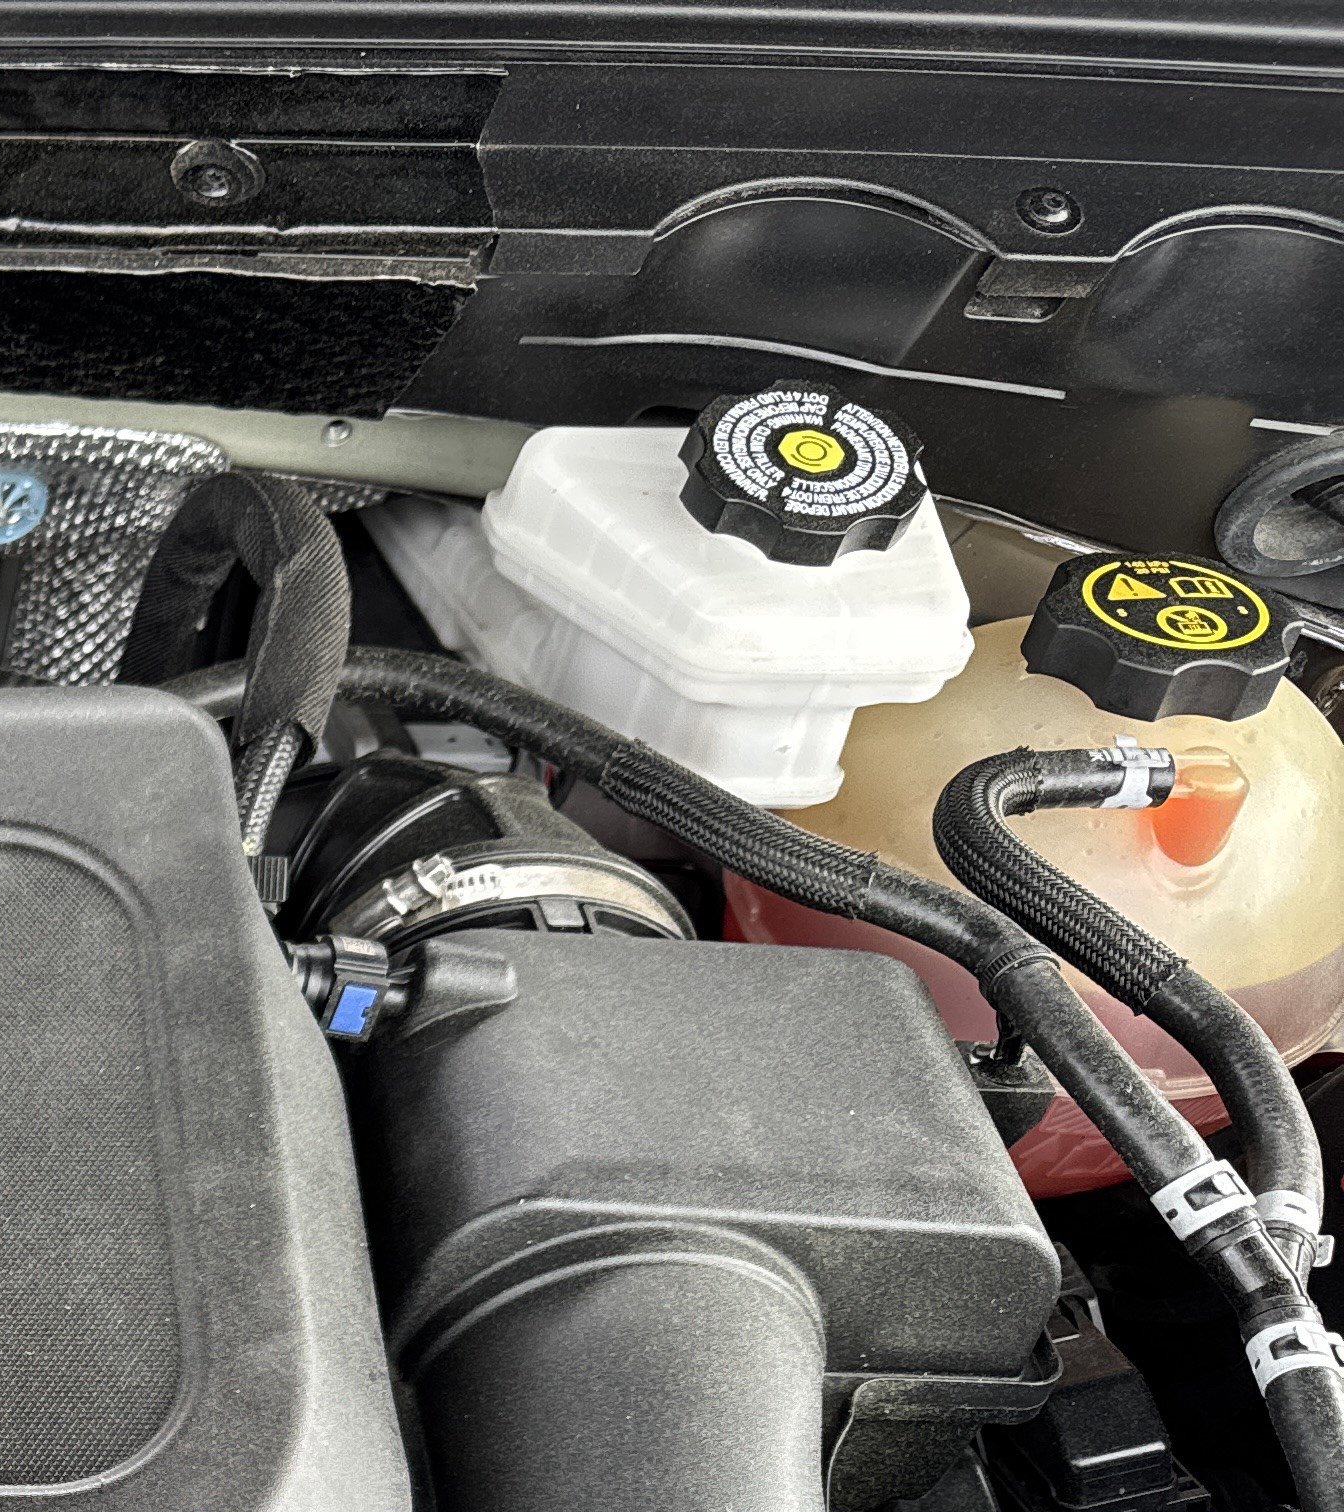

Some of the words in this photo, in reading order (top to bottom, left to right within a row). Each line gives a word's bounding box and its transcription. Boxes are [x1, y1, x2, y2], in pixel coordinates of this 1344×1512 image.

[756, 390, 794, 406] FLUID
[801, 391, 830, 406] DOT
[726, 397, 761, 419] FROM
[799, 401, 828, 416] CAP
[712, 419, 734, 454] SEALED
[732, 452, 756, 471] USE
[751, 452, 786, 482] FILLER
[745, 467, 779, 489] ONLY
[788, 488, 814, 504] DOT
